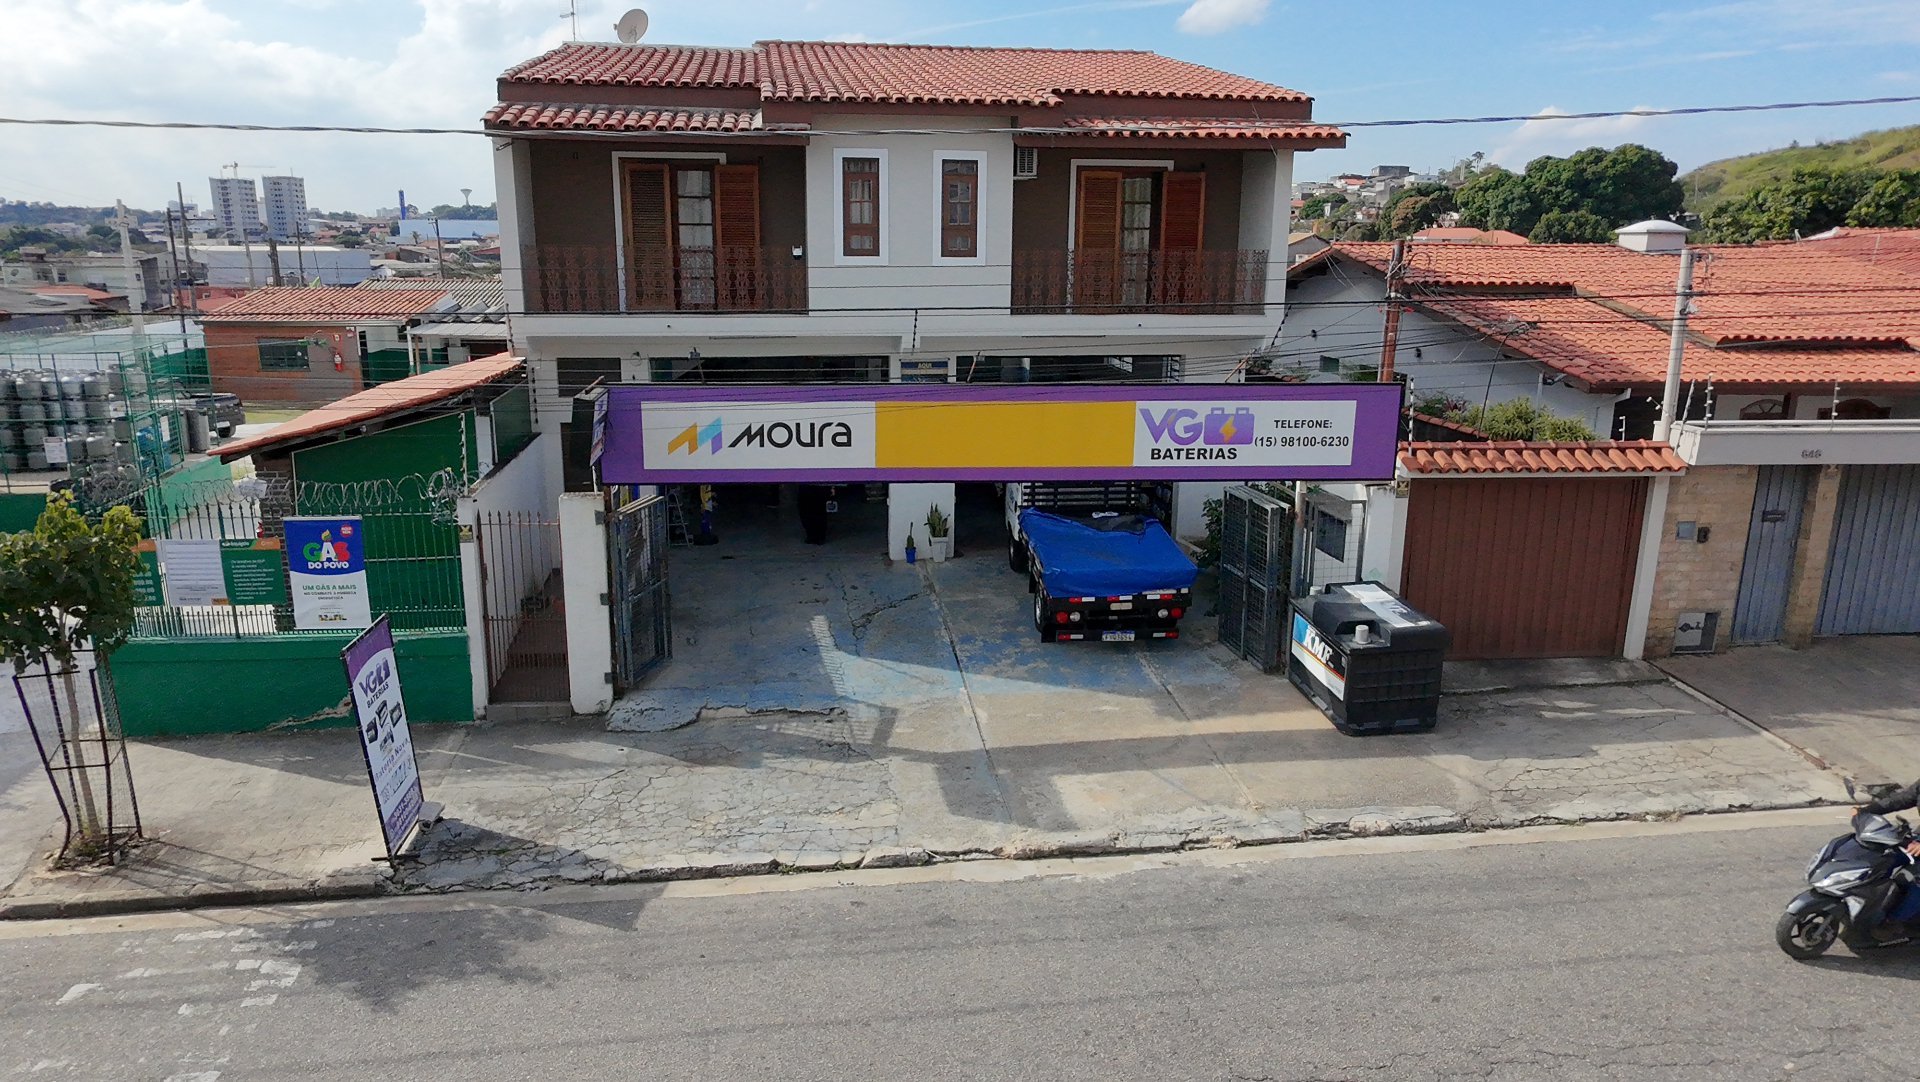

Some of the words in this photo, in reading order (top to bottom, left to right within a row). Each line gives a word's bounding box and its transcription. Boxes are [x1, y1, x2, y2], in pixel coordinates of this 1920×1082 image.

[1139, 408, 1203, 445] VG
[1274, 419, 1333, 429] TELEFONE:
[1254, 436, 1277, 448] (15)
[1281, 436, 1350, 447] 98100-6230
[1150, 447, 1238, 460] BATERIAS
[308, 561, 322, 569] DO
[358, 670, 378, 698] VG
[366, 681, 390, 709] BATERIAS
